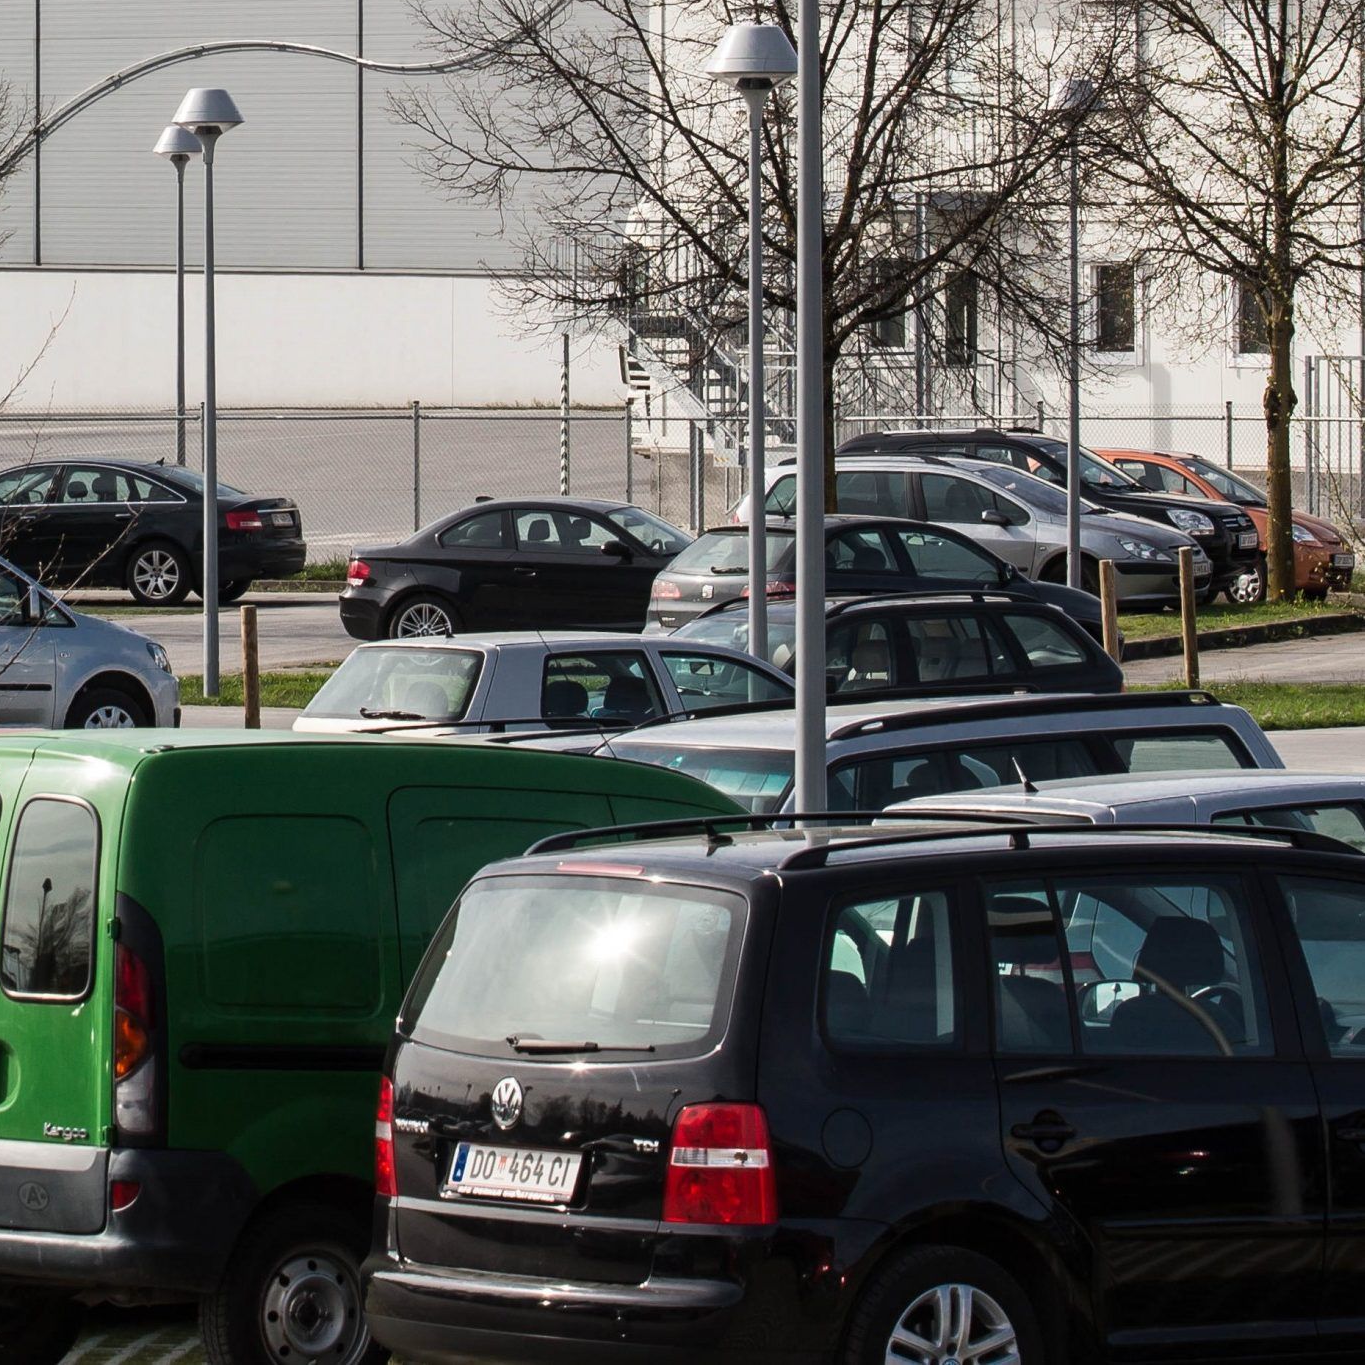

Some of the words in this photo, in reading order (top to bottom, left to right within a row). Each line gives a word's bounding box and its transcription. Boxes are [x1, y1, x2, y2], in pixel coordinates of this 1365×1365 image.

[43, 1122, 88, 1141] Kangoo
[633, 1138, 660, 1153] TDI
[469, 1148, 497, 1181] DO
